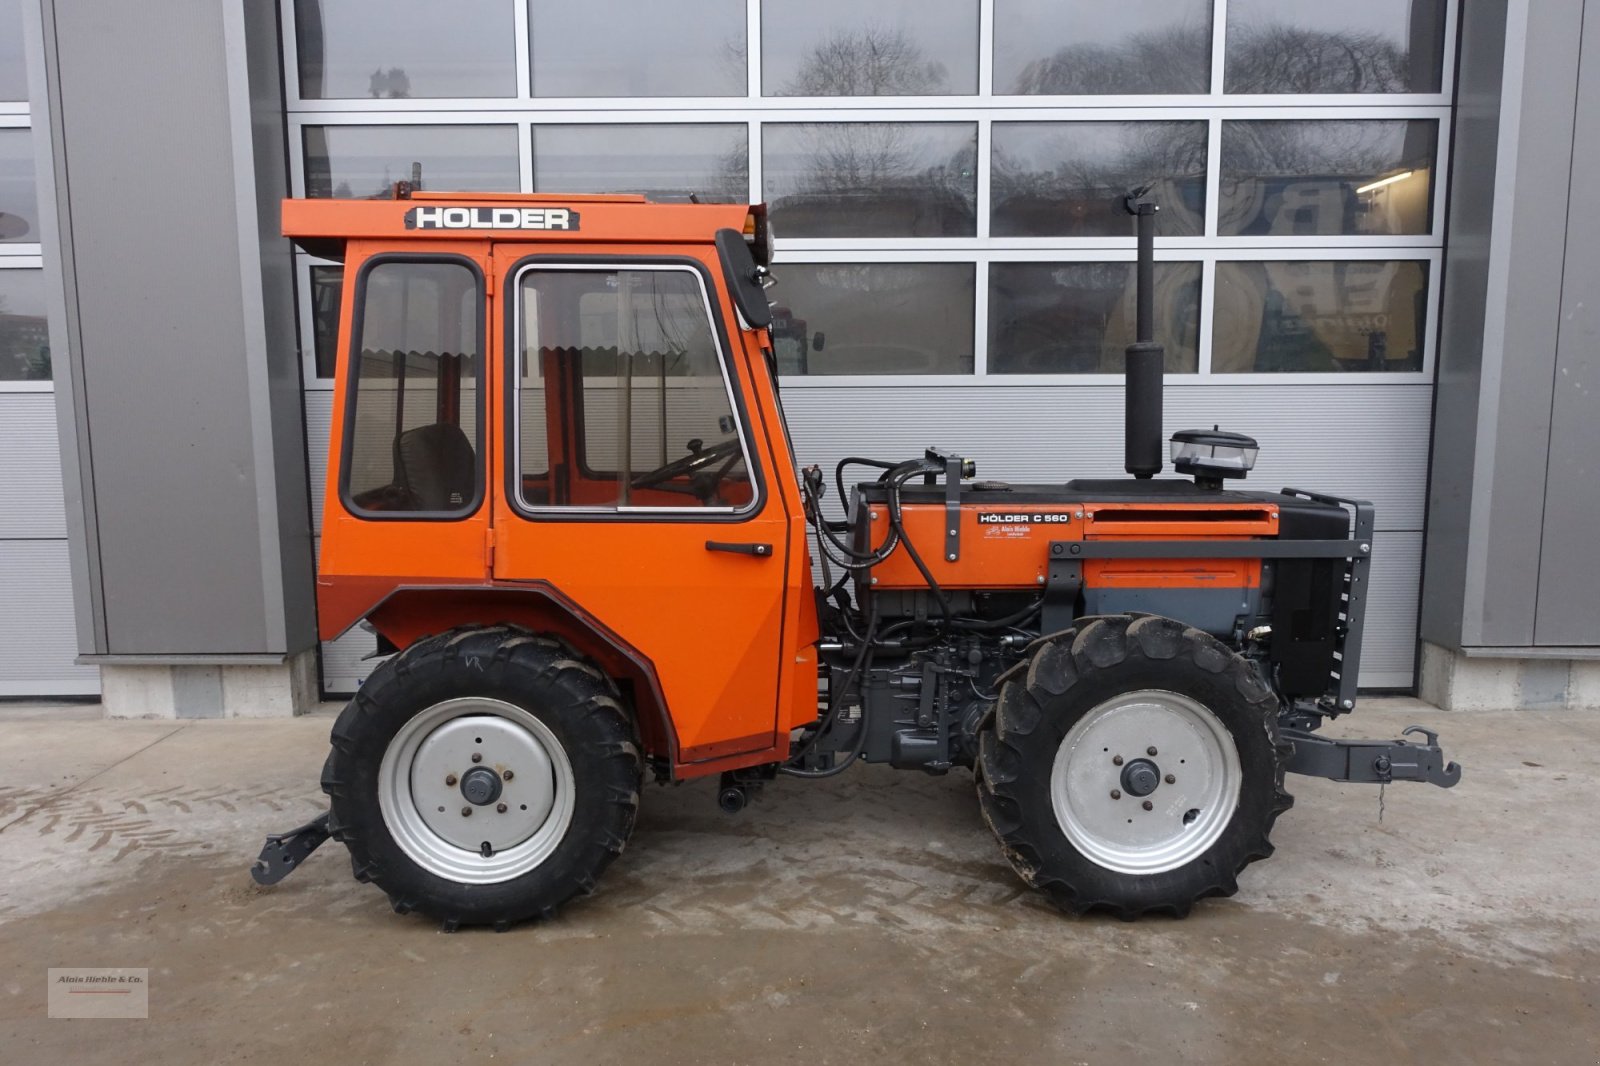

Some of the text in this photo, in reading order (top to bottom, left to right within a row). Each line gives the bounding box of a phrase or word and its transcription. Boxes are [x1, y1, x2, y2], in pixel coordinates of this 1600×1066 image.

[416, 207, 570, 230] HOLDER
[1033, 514, 1042, 523] C
[1044, 514, 1068, 523] 560
